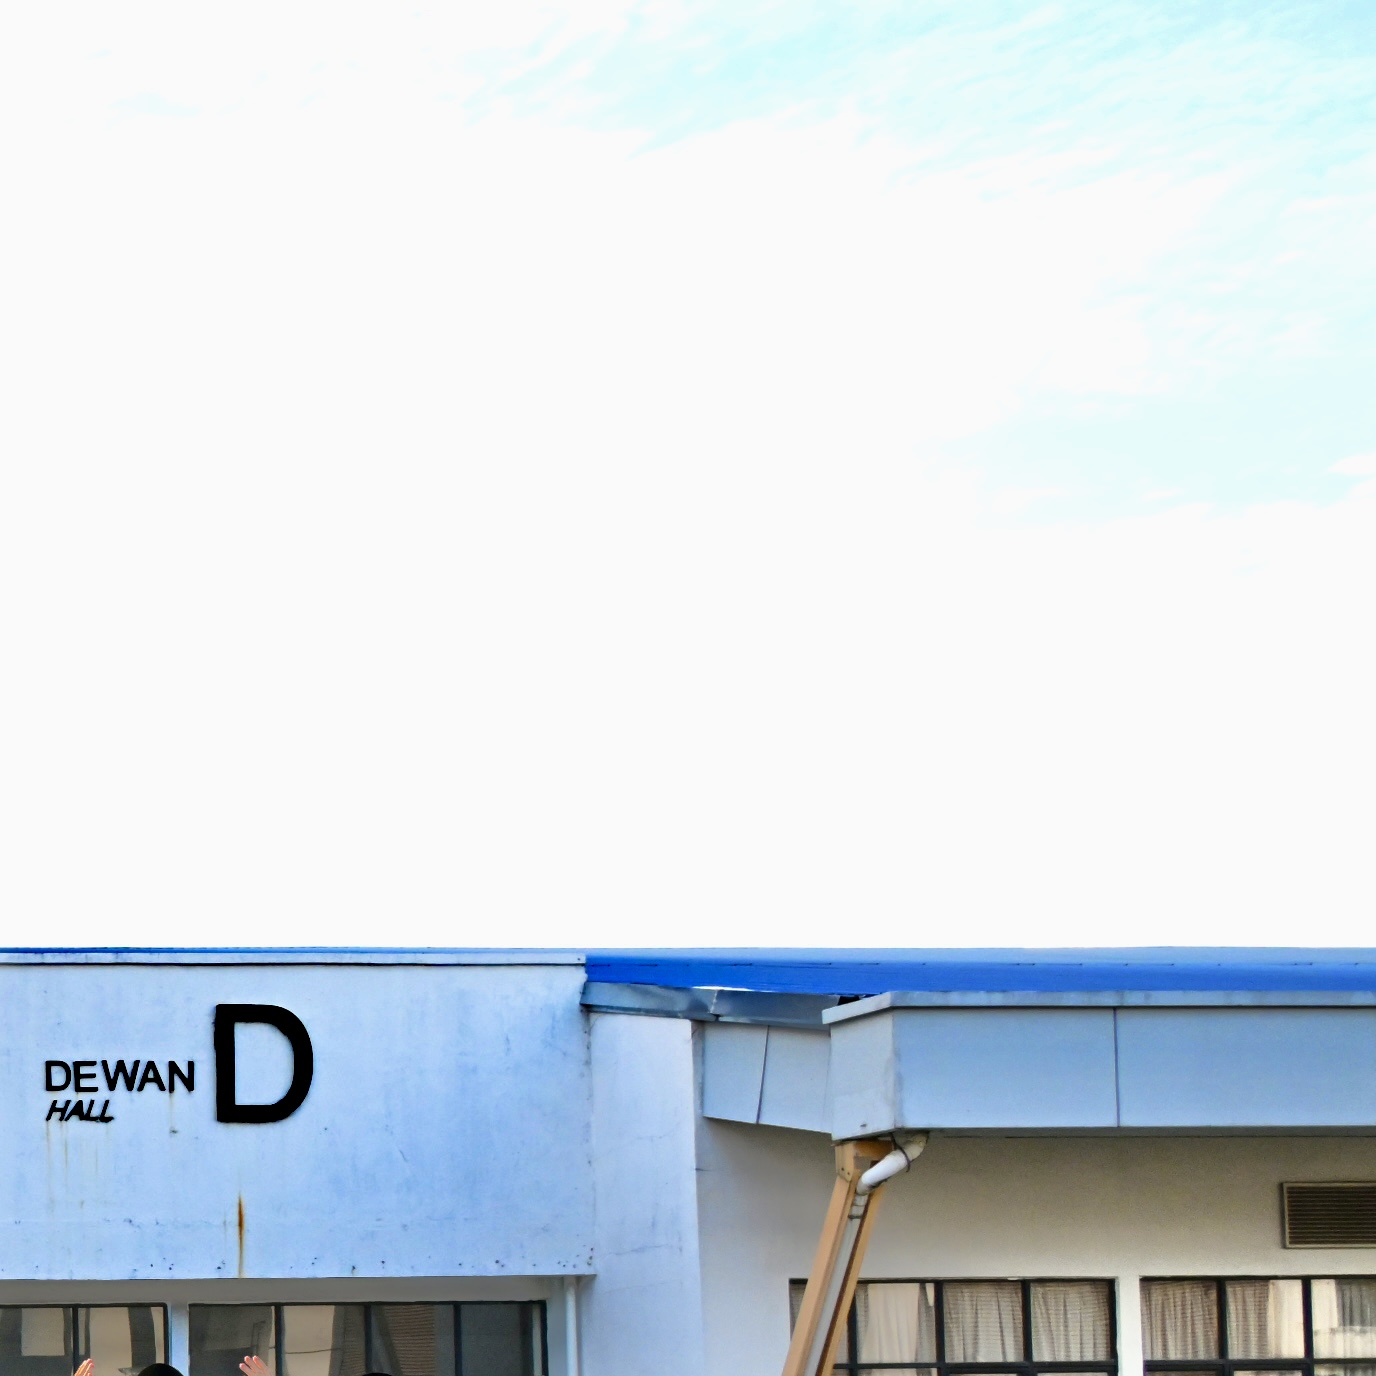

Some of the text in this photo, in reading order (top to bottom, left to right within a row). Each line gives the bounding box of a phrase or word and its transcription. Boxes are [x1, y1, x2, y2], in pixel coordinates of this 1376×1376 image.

[45, 1059, 195, 1093] DEWAN
[213, 1003, 314, 1123] D
[46, 1099, 114, 1123] HALL
